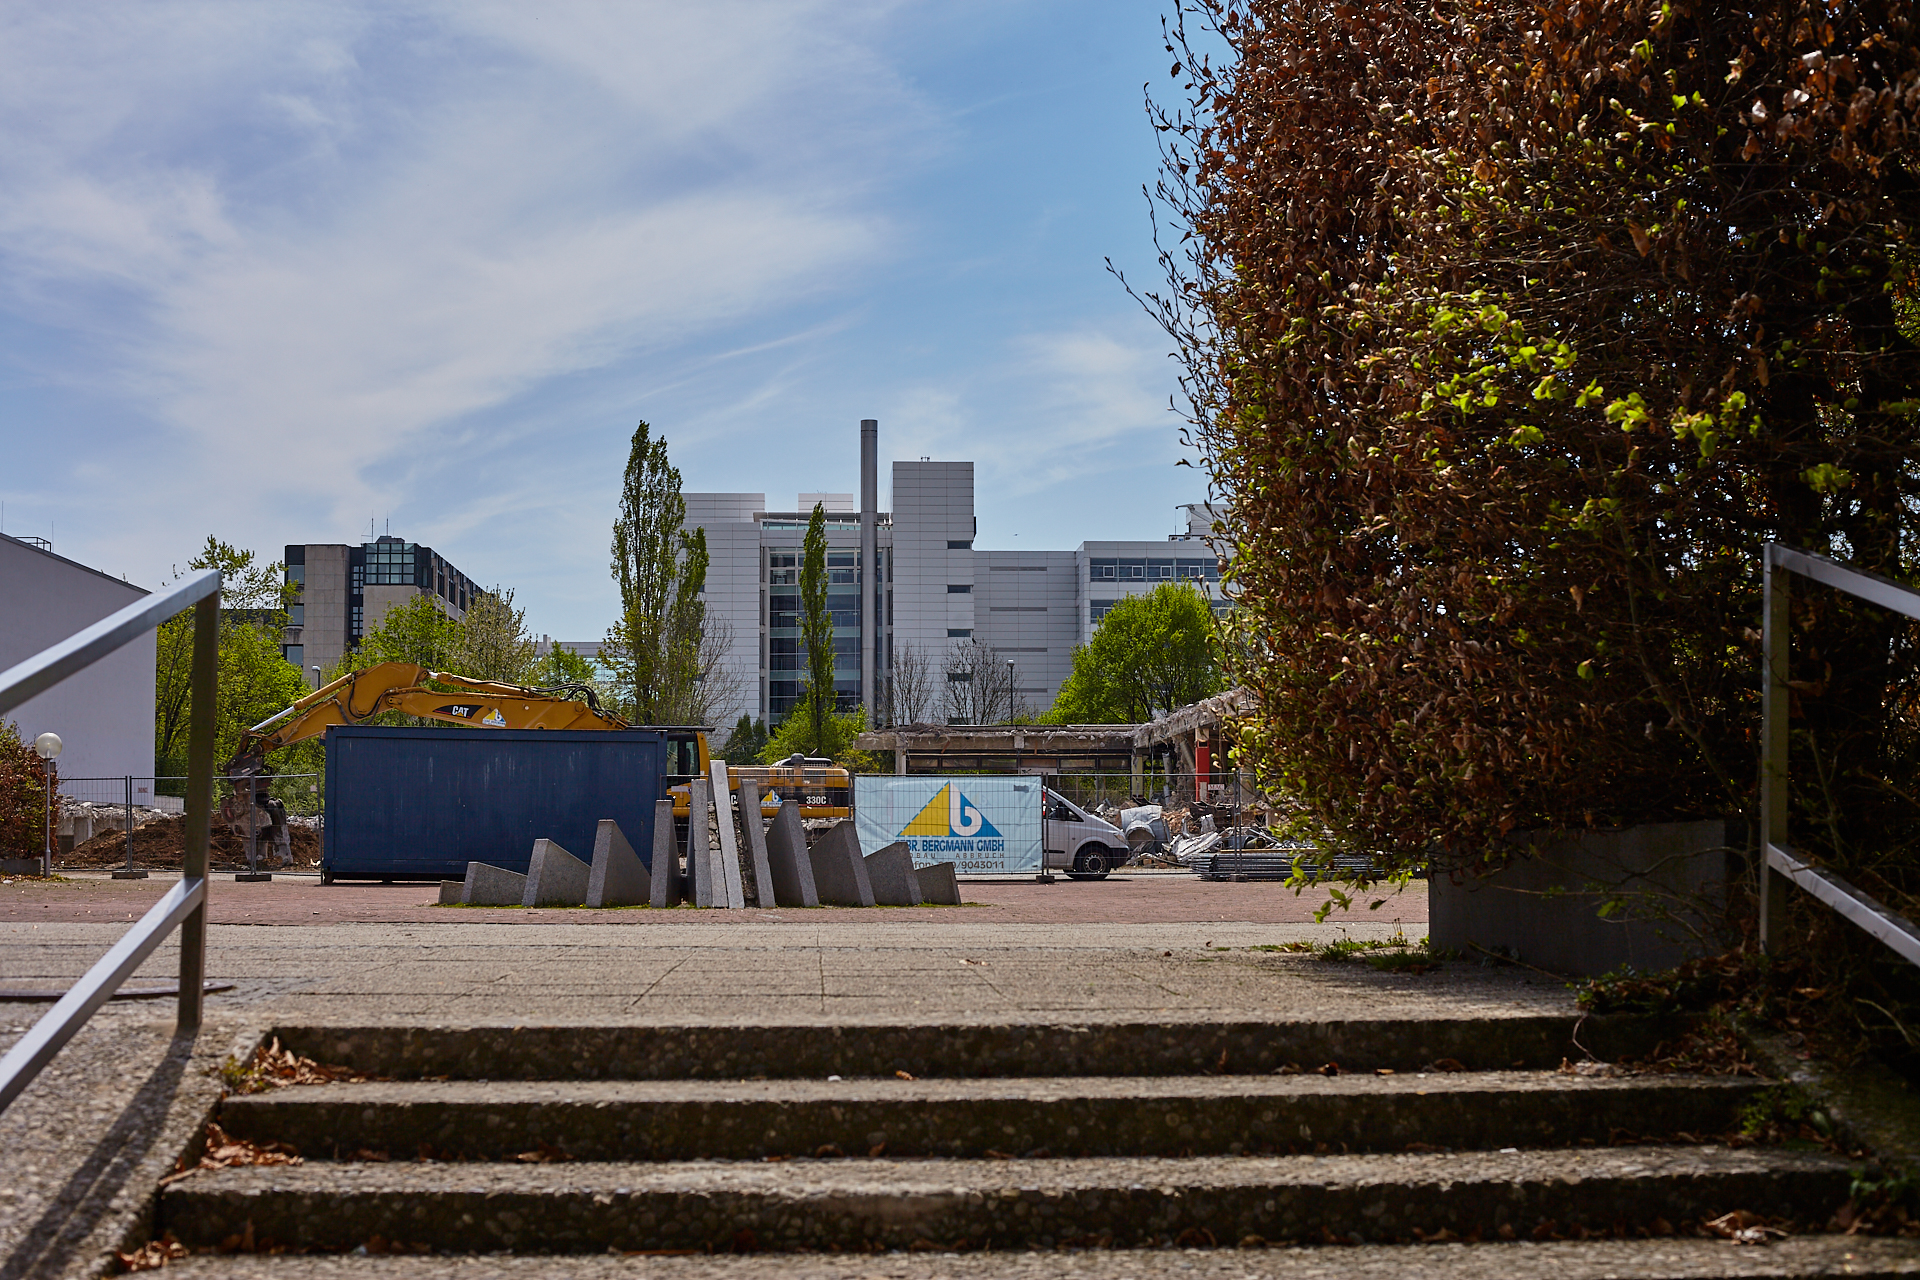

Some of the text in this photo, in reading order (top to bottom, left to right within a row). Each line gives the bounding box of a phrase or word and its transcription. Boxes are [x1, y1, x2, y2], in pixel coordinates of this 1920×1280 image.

[452, 705, 469, 717] CAT
[806, 796, 826, 804] 330C
[895, 839, 1004, 851] BR. BERGMANN GMBH
